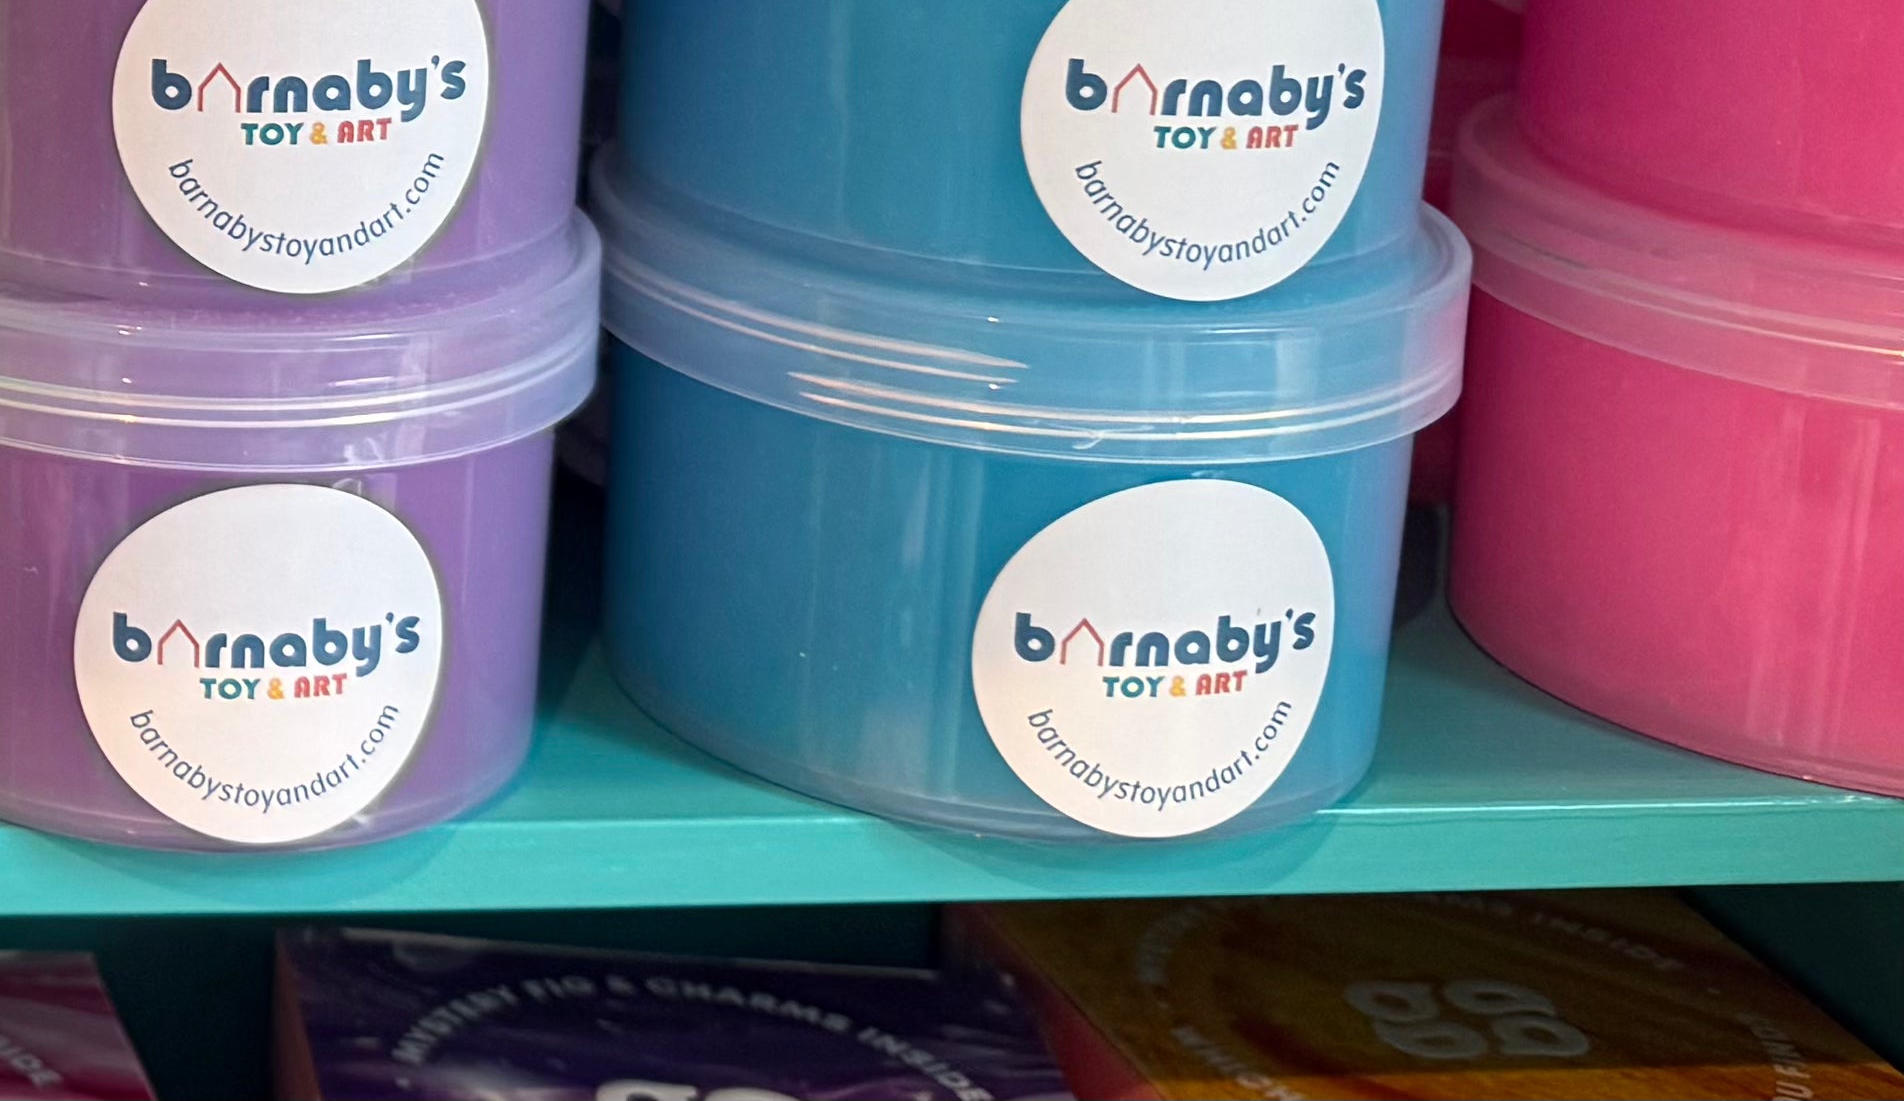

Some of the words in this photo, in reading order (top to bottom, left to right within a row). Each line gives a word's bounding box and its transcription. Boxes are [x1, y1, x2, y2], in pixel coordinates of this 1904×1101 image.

[239, 120, 304, 147] TOY
[309, 120, 329, 147] &
[336, 115, 392, 144] ART
[1153, 122, 1215, 151] TOY
[1219, 124, 1239, 151] &
[1244, 122, 1299, 151] ART
[168, 149, 446, 266] barnabystoyandart.com
[1074, 157, 1342, 272] barnabystoyandart.com
[199, 676, 261, 701] TOY
[265, 676, 286, 703] &
[293, 672, 349, 699] ART
[1101, 672, 1165, 699] TOY
[1169, 672, 1188, 698] &
[1193, 666, 1248, 694] ART
[129, 703, 400, 814] barnabystoyandart.com
[1026, 699, 1294, 812] barnabystoyandart.com
[391, 984, 519, 1066] MYSTERY
[520, 975, 595, 1002] FIG
[605, 974, 635, 996] &
[645, 976, 851, 1032] CHARMS
